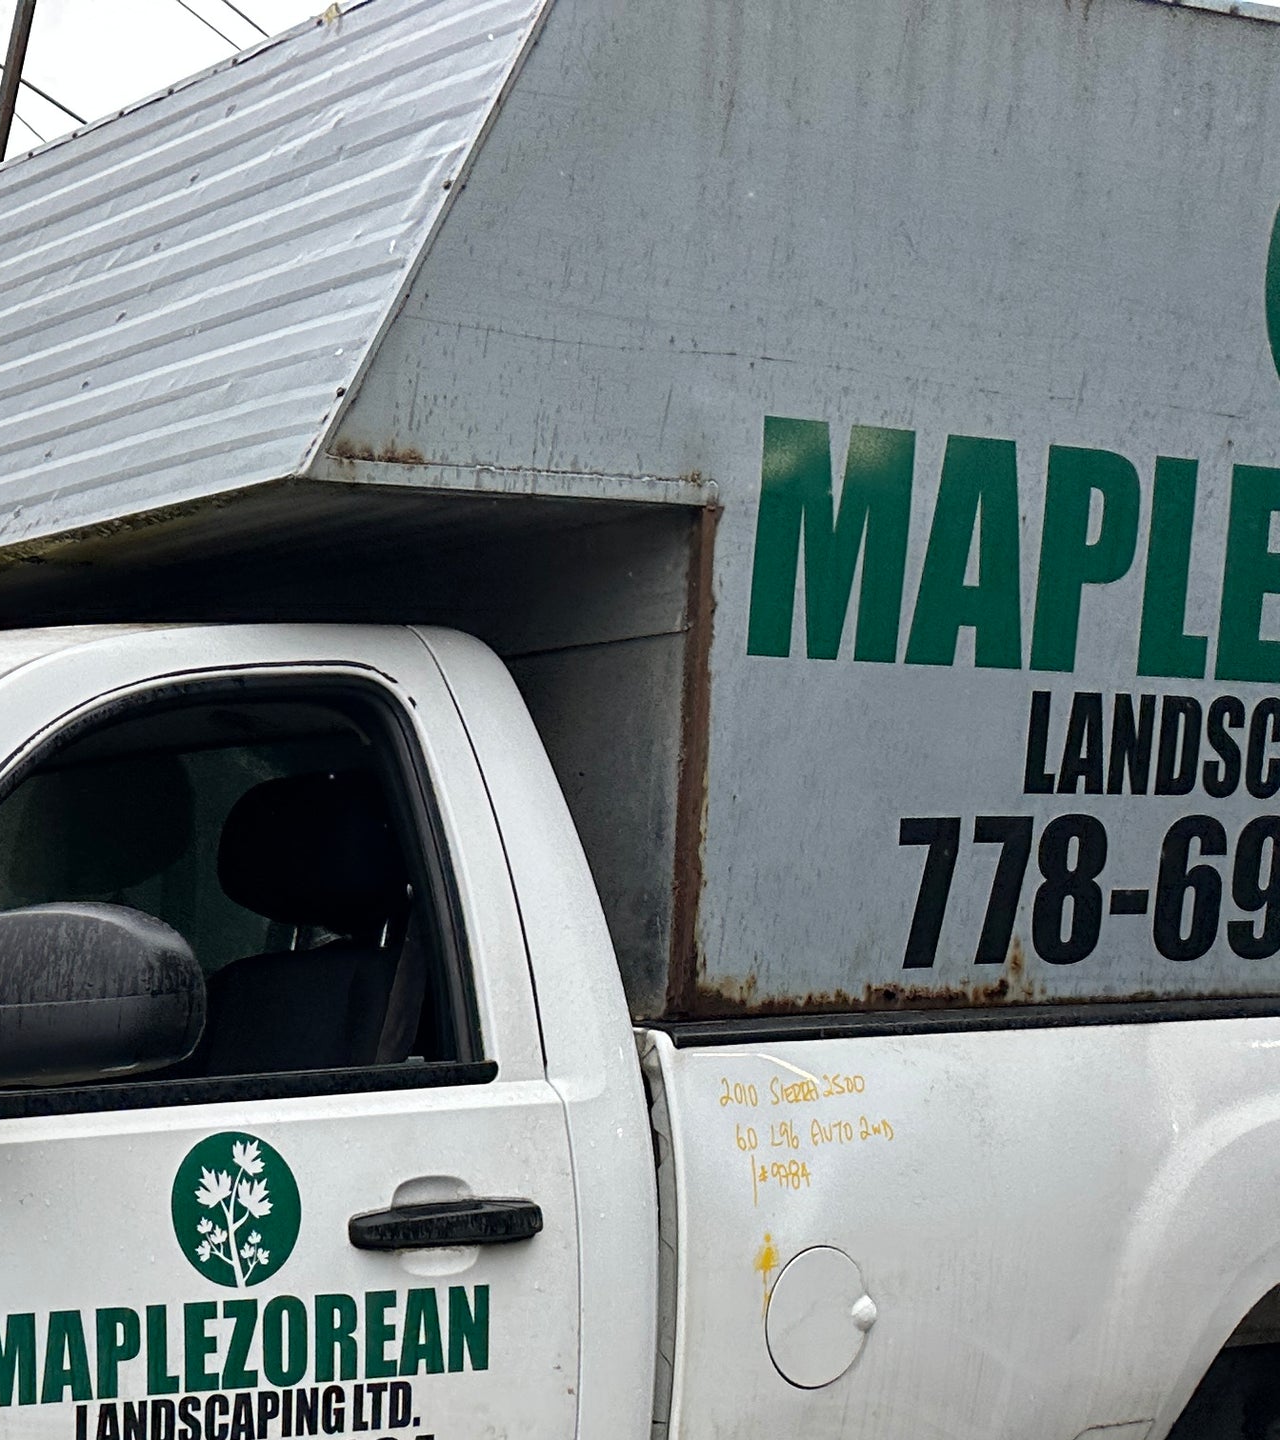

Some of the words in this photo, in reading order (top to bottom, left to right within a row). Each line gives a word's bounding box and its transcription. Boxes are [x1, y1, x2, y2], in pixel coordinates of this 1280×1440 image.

[746, 415, 1280, 685] MAPLE
[811, 1118, 854, 1146] AUTO
[352, 1381, 422, 1432] LTD.
